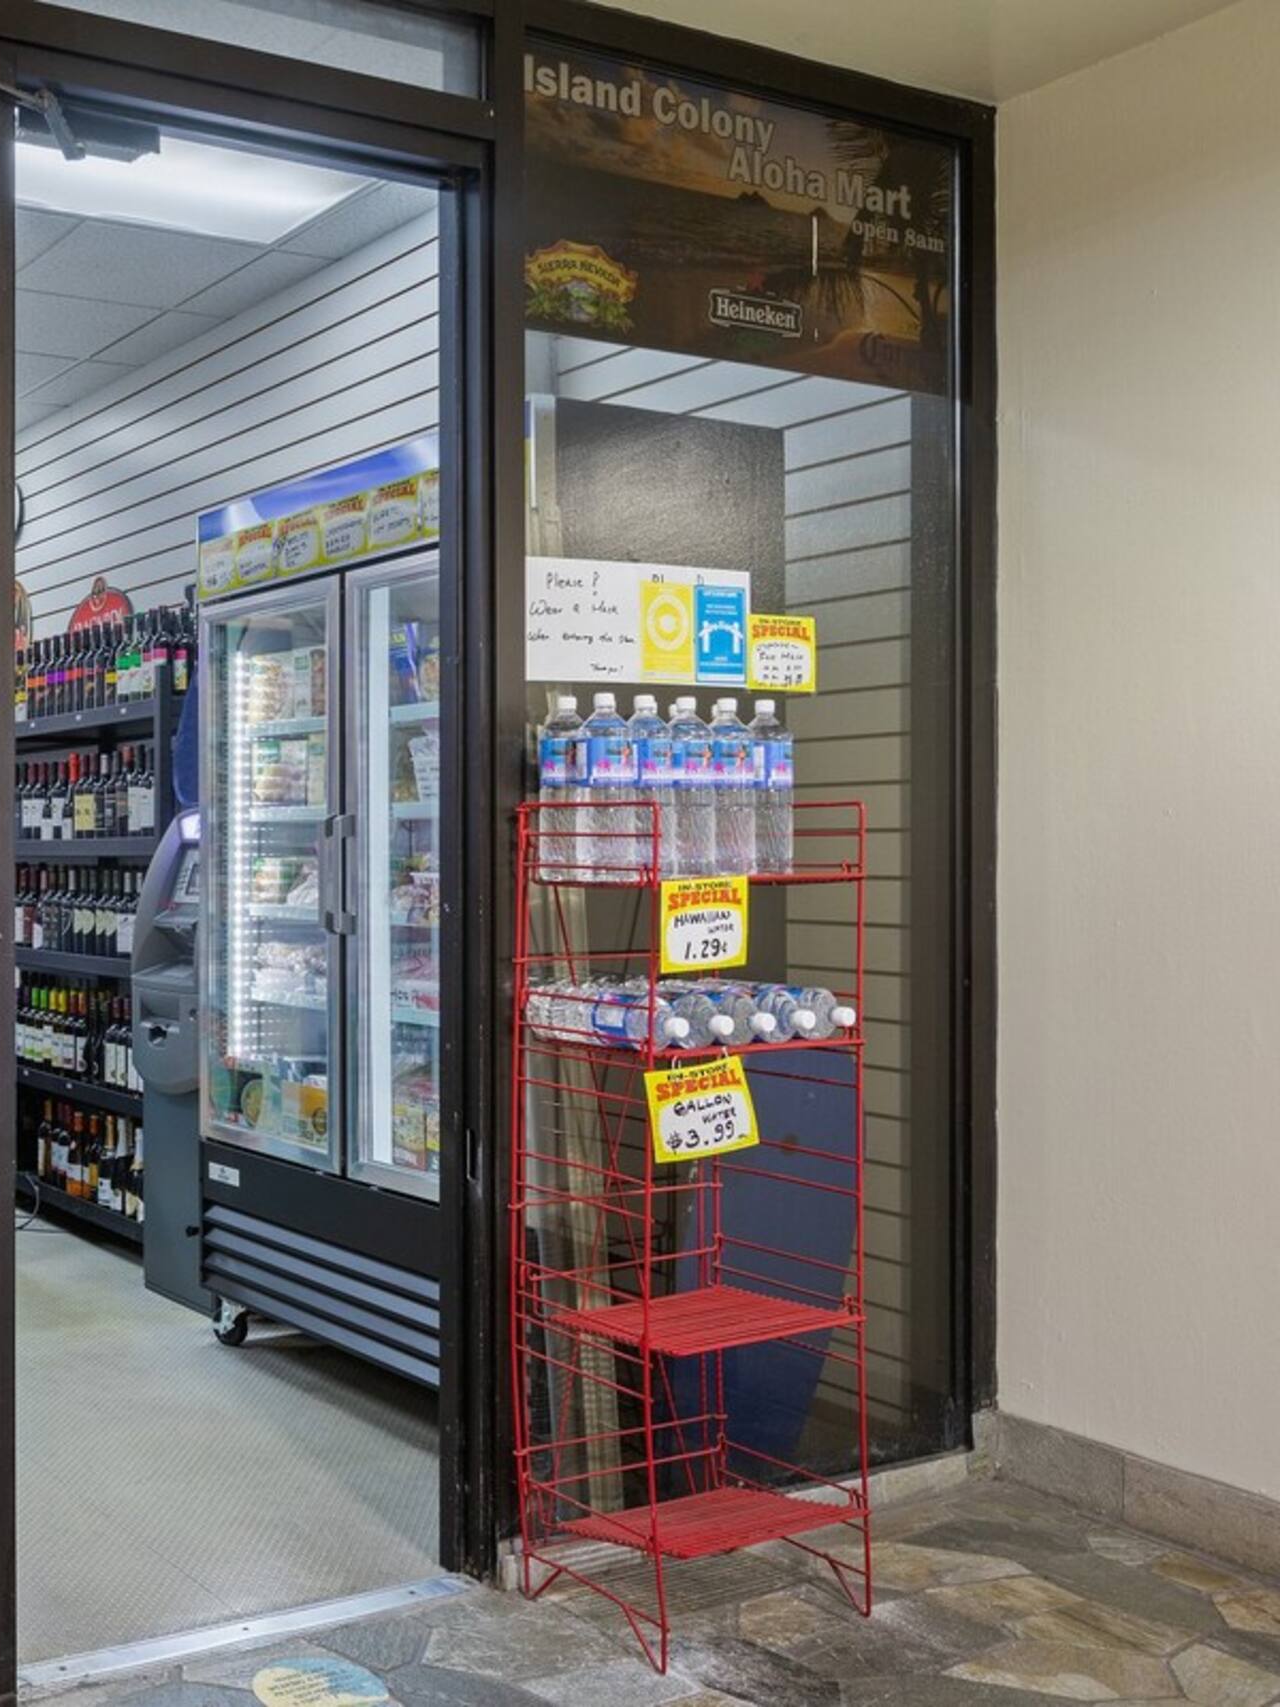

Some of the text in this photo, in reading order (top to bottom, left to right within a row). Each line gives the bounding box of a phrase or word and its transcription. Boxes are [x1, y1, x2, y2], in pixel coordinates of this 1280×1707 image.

[523, 54, 775, 153] Island Colony
[727, 148, 912, 219] Aloha Mart
[852, 218, 946, 252] open 8am
[716, 297, 797, 330] Heineken
[667, 888, 742, 912] SPECIAL
[678, 881, 732, 892] IN-STORE
[655, 1069, 742, 1102] SPECIAL
[673, 1092, 732, 1116] GALLON
[702, 1107, 737, 1124] WATER
